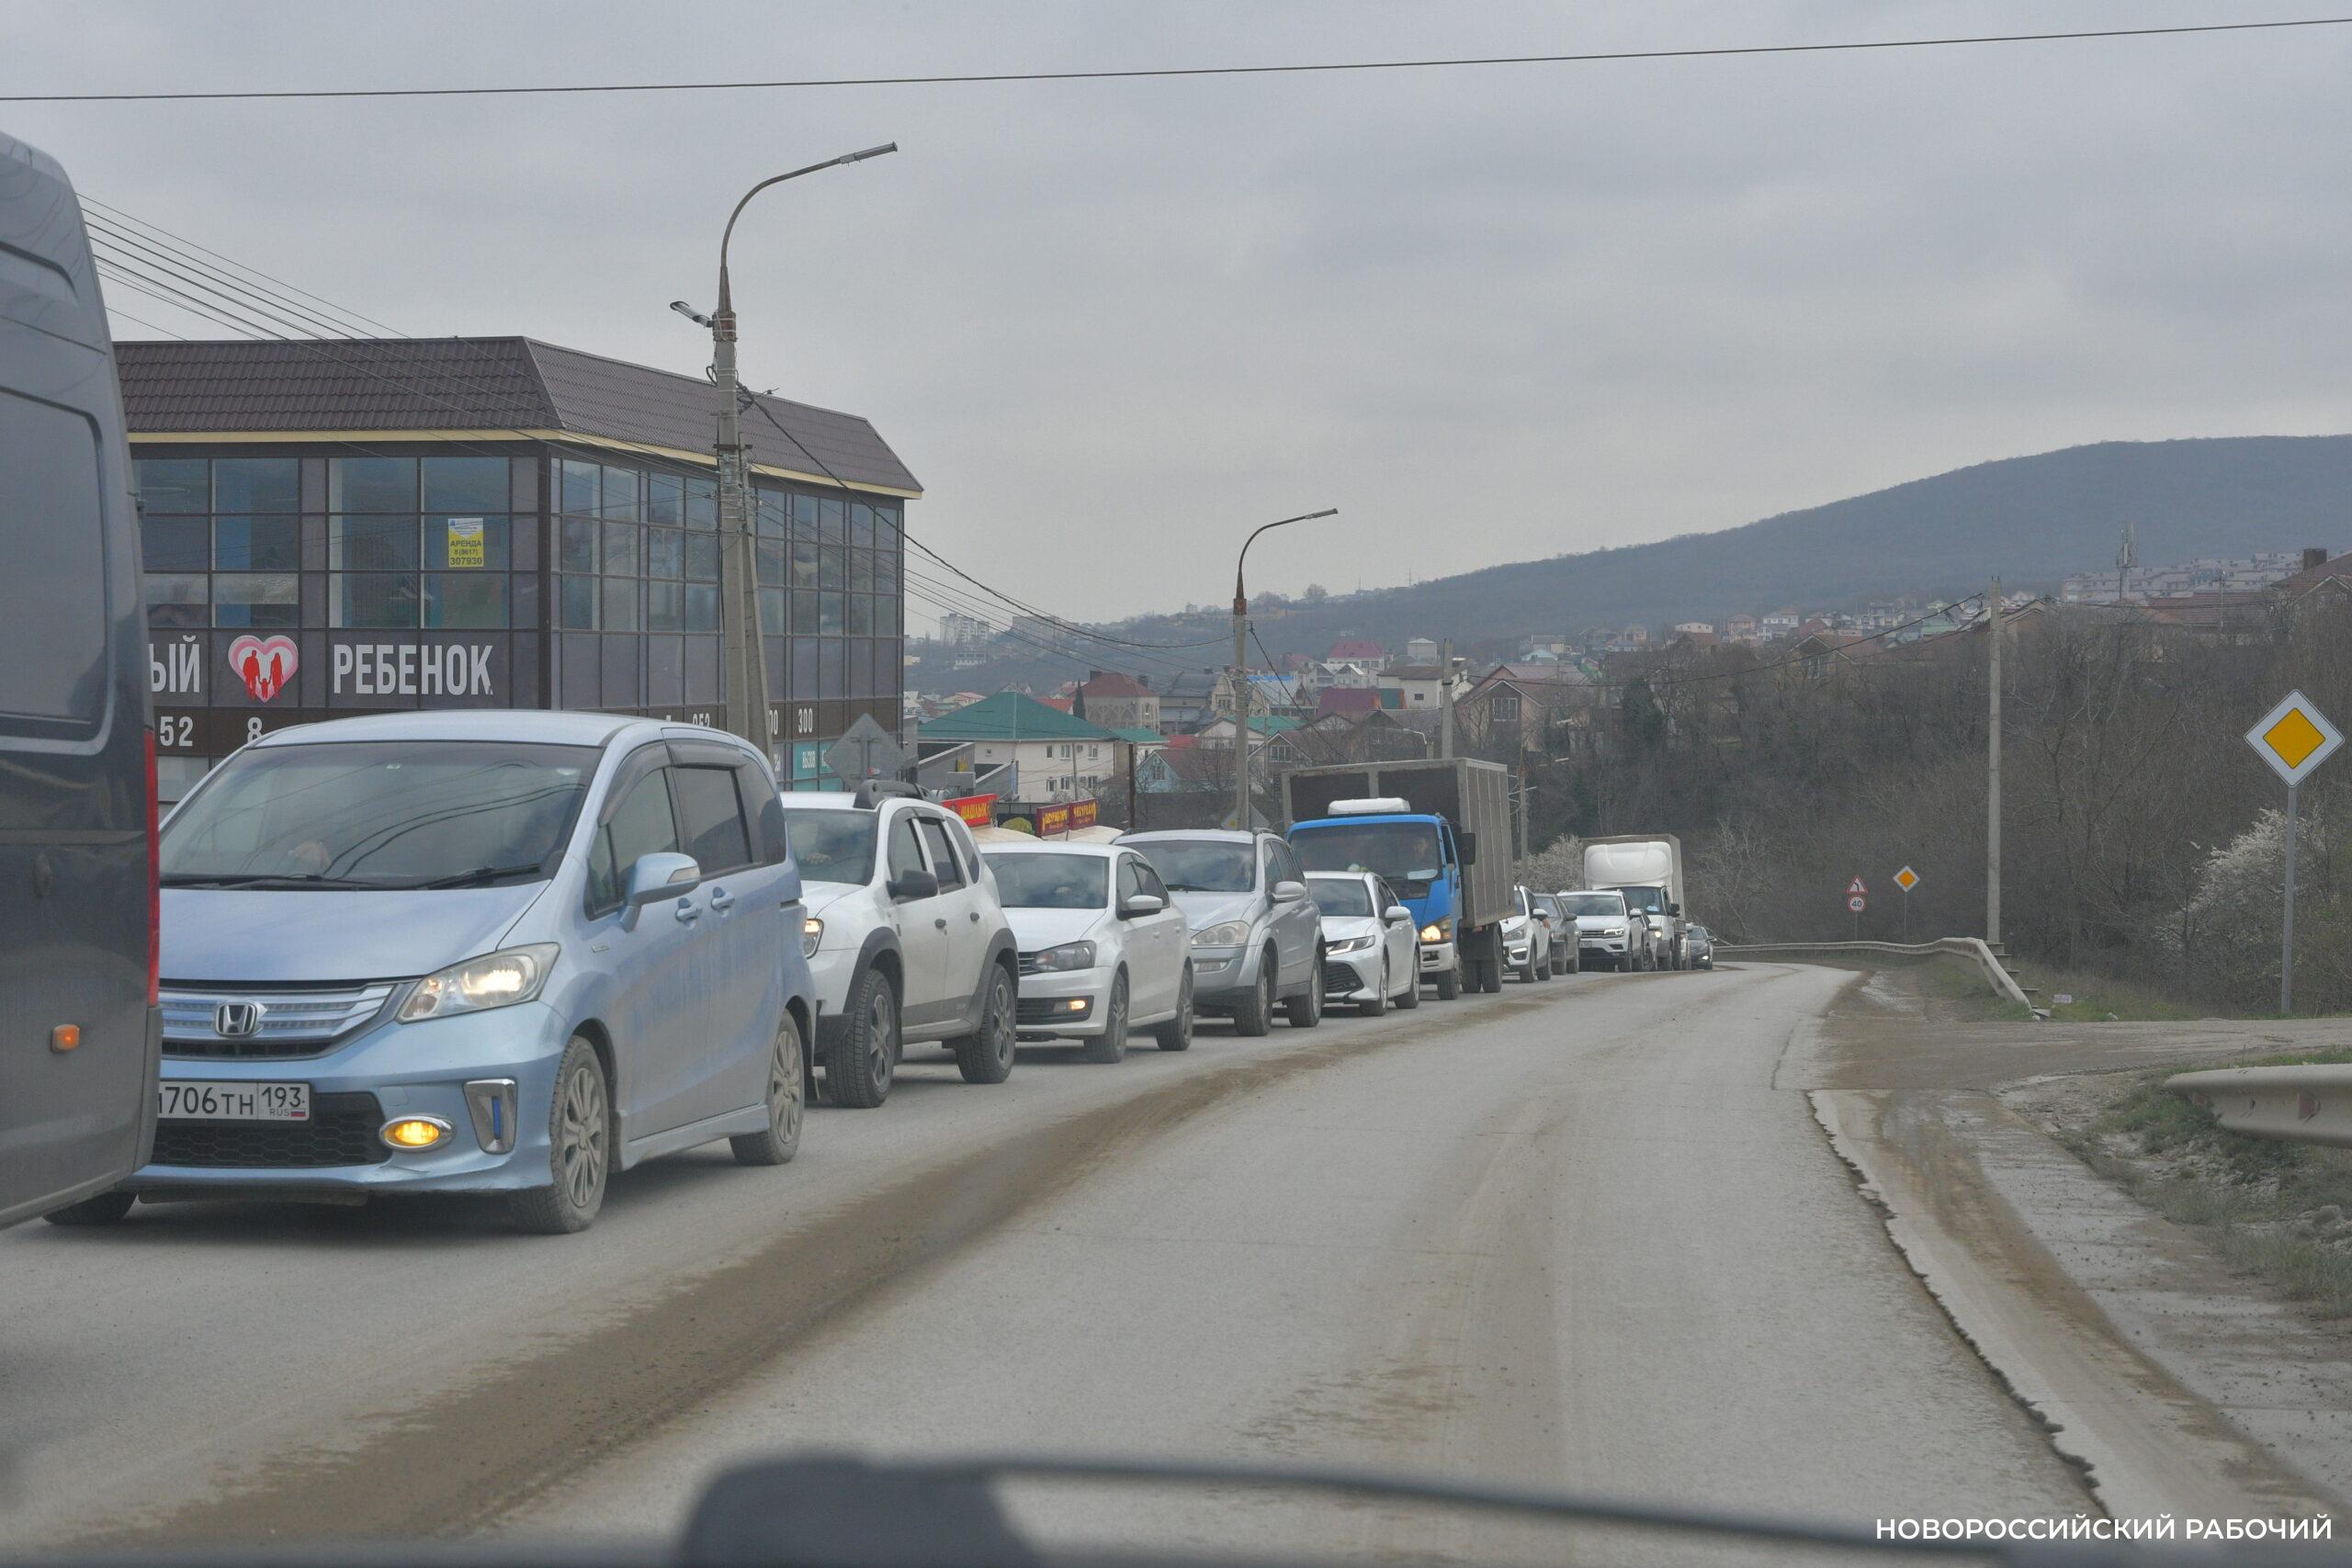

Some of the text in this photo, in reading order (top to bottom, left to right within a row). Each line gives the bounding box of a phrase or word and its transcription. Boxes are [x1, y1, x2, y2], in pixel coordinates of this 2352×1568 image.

[450, 557, 483, 565] 307930
[334, 644, 493, 695] РЕБЕНОК
[159, 716, 194, 747] 52
[797, 707, 813, 733] 300
[261, 1086, 301, 1108] 193
[270, 1108, 290, 1117] RUS
